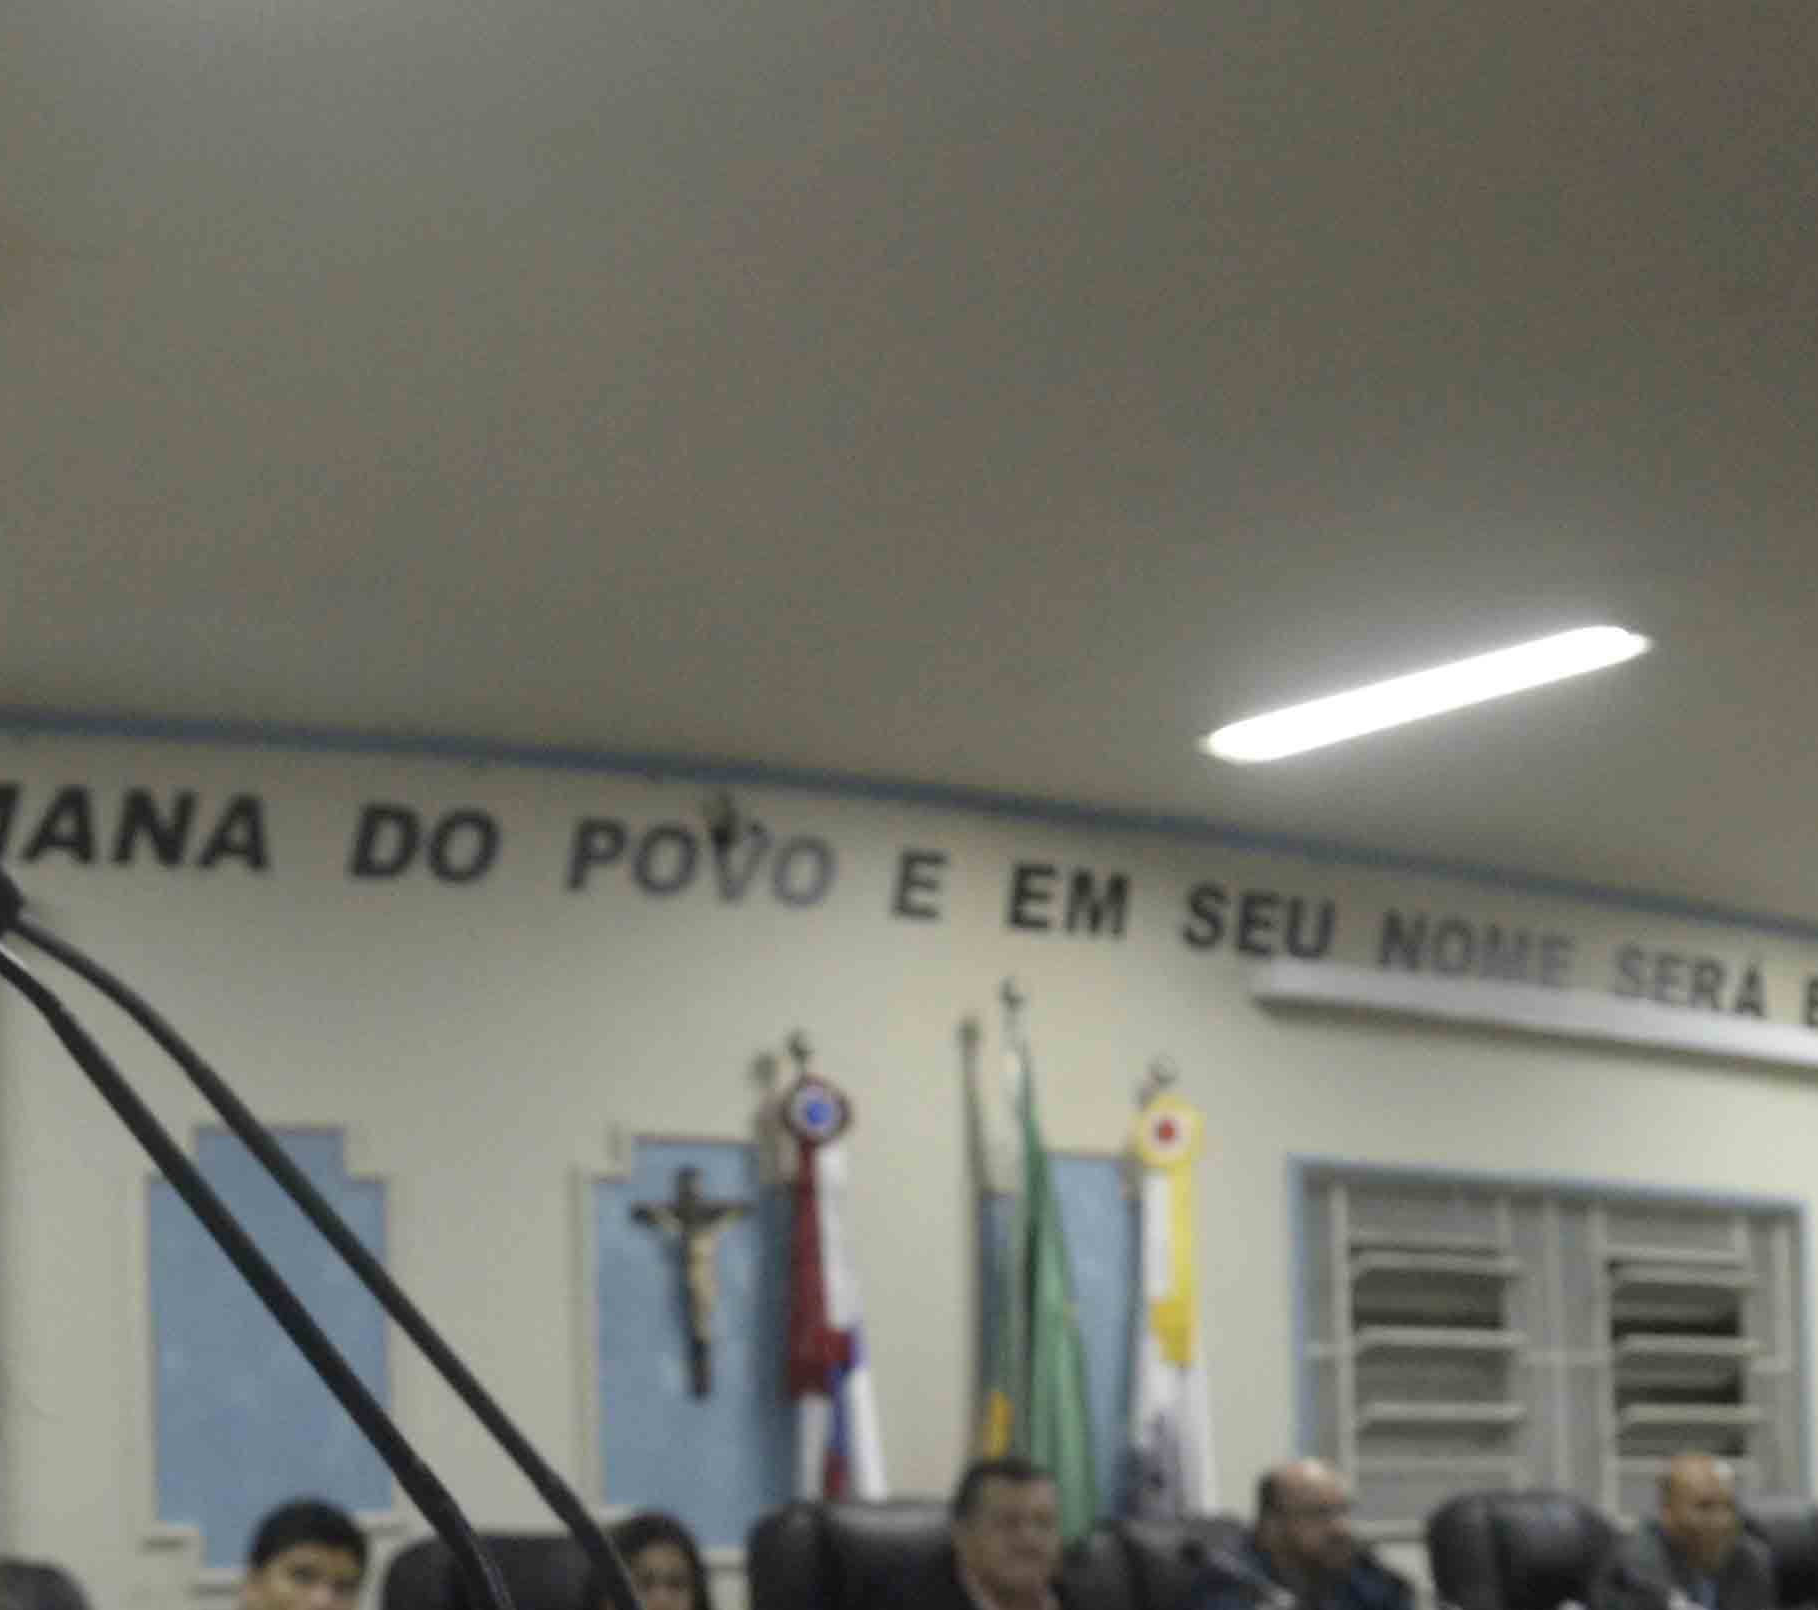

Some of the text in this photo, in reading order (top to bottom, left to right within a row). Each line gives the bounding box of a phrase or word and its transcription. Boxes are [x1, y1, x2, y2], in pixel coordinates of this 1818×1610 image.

[349, 803, 500, 885] DO
[566, 817, 835, 908] POVO
[892, 849, 948, 919] E
[1007, 862, 1131, 938] EM
[1182, 881, 1334, 960] SEU
[1377, 910, 1571, 987] NOME
[1614, 945, 1766, 1020] SERÁ
